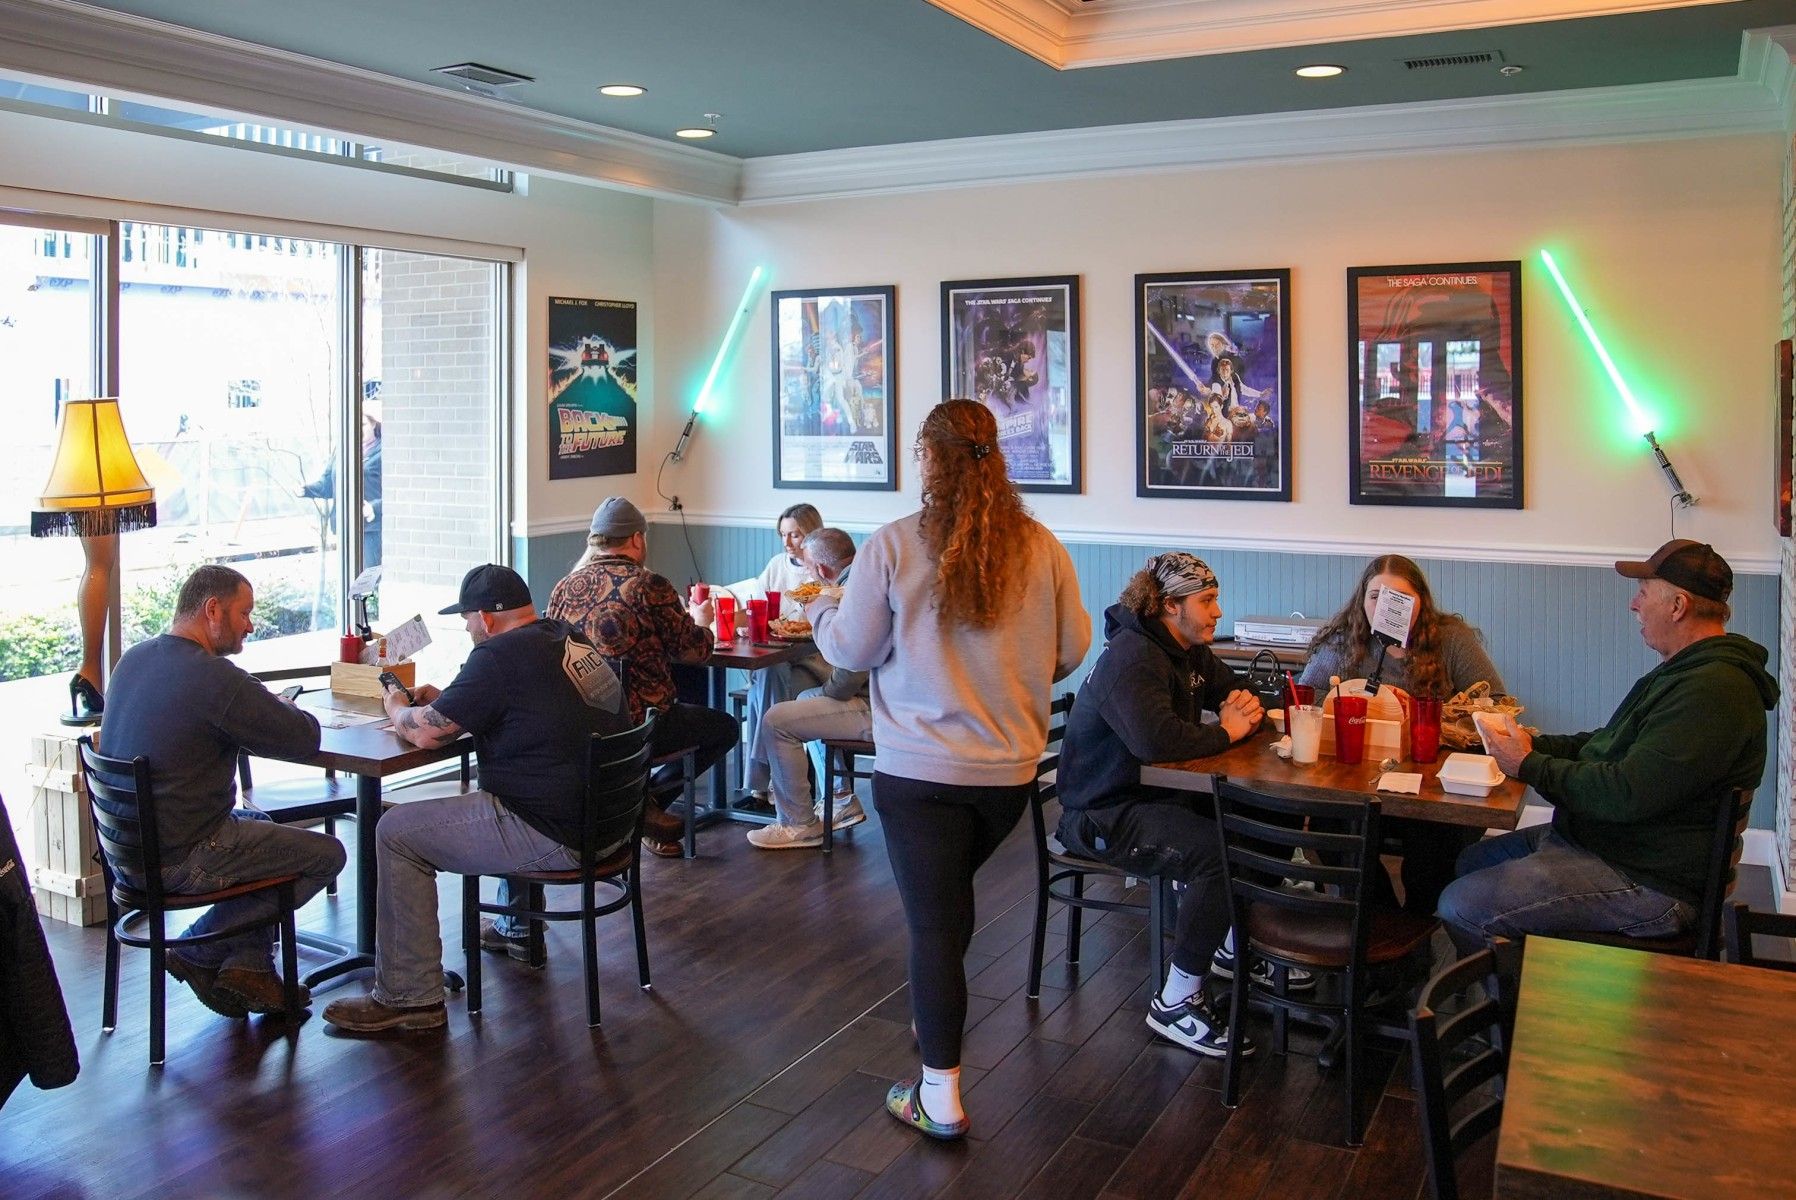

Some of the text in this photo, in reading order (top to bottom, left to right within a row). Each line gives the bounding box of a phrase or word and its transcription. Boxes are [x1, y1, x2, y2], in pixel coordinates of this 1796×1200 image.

[1387, 278, 1401, 287] THE
[1403, 277, 1427, 287] SAGA
[558, 408, 628, 433] BACK
[572, 430, 627, 452] FUTURE
[850, 441, 877, 451] STAR
[1172, 444, 1219, 456] RETURN
[1226, 444, 1254, 462] JEDI
